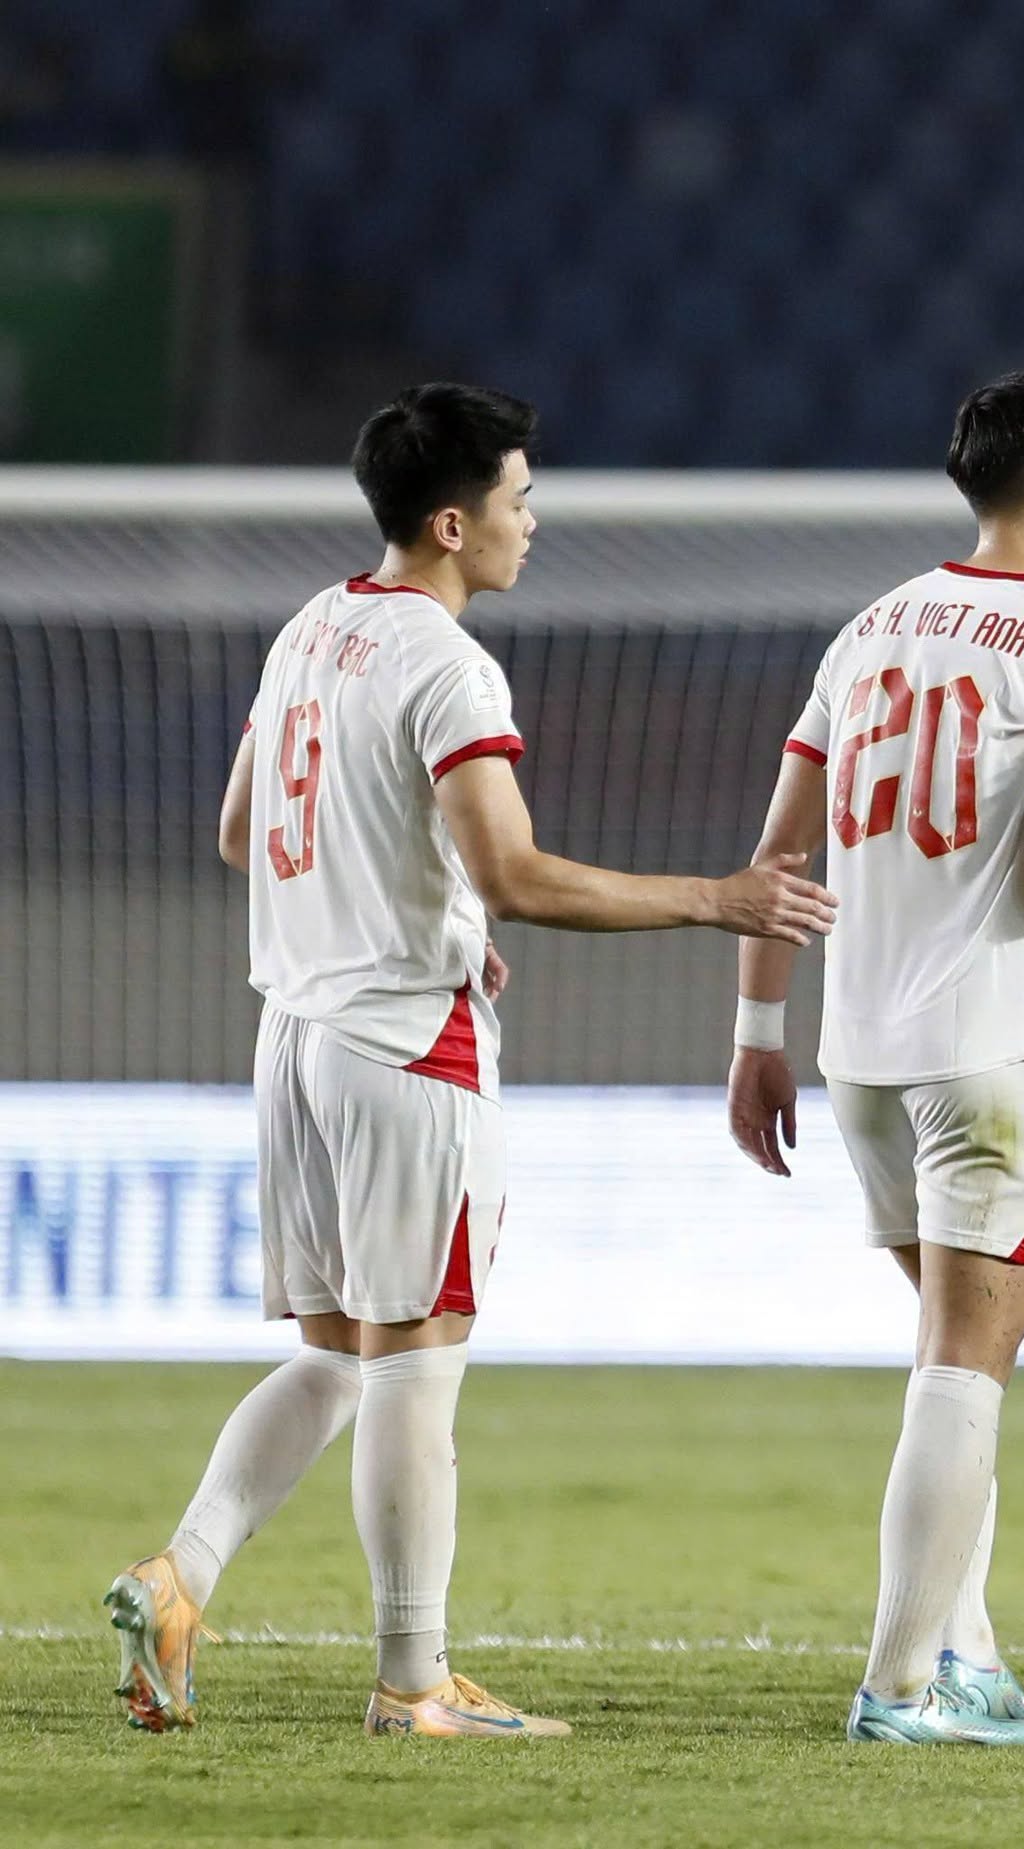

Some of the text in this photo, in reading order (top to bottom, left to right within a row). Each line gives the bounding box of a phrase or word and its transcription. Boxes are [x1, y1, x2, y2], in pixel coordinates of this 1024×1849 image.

[914, 601, 976, 639] VIET
[266, 698, 322, 882] 9
[832, 667, 985, 860] 20
